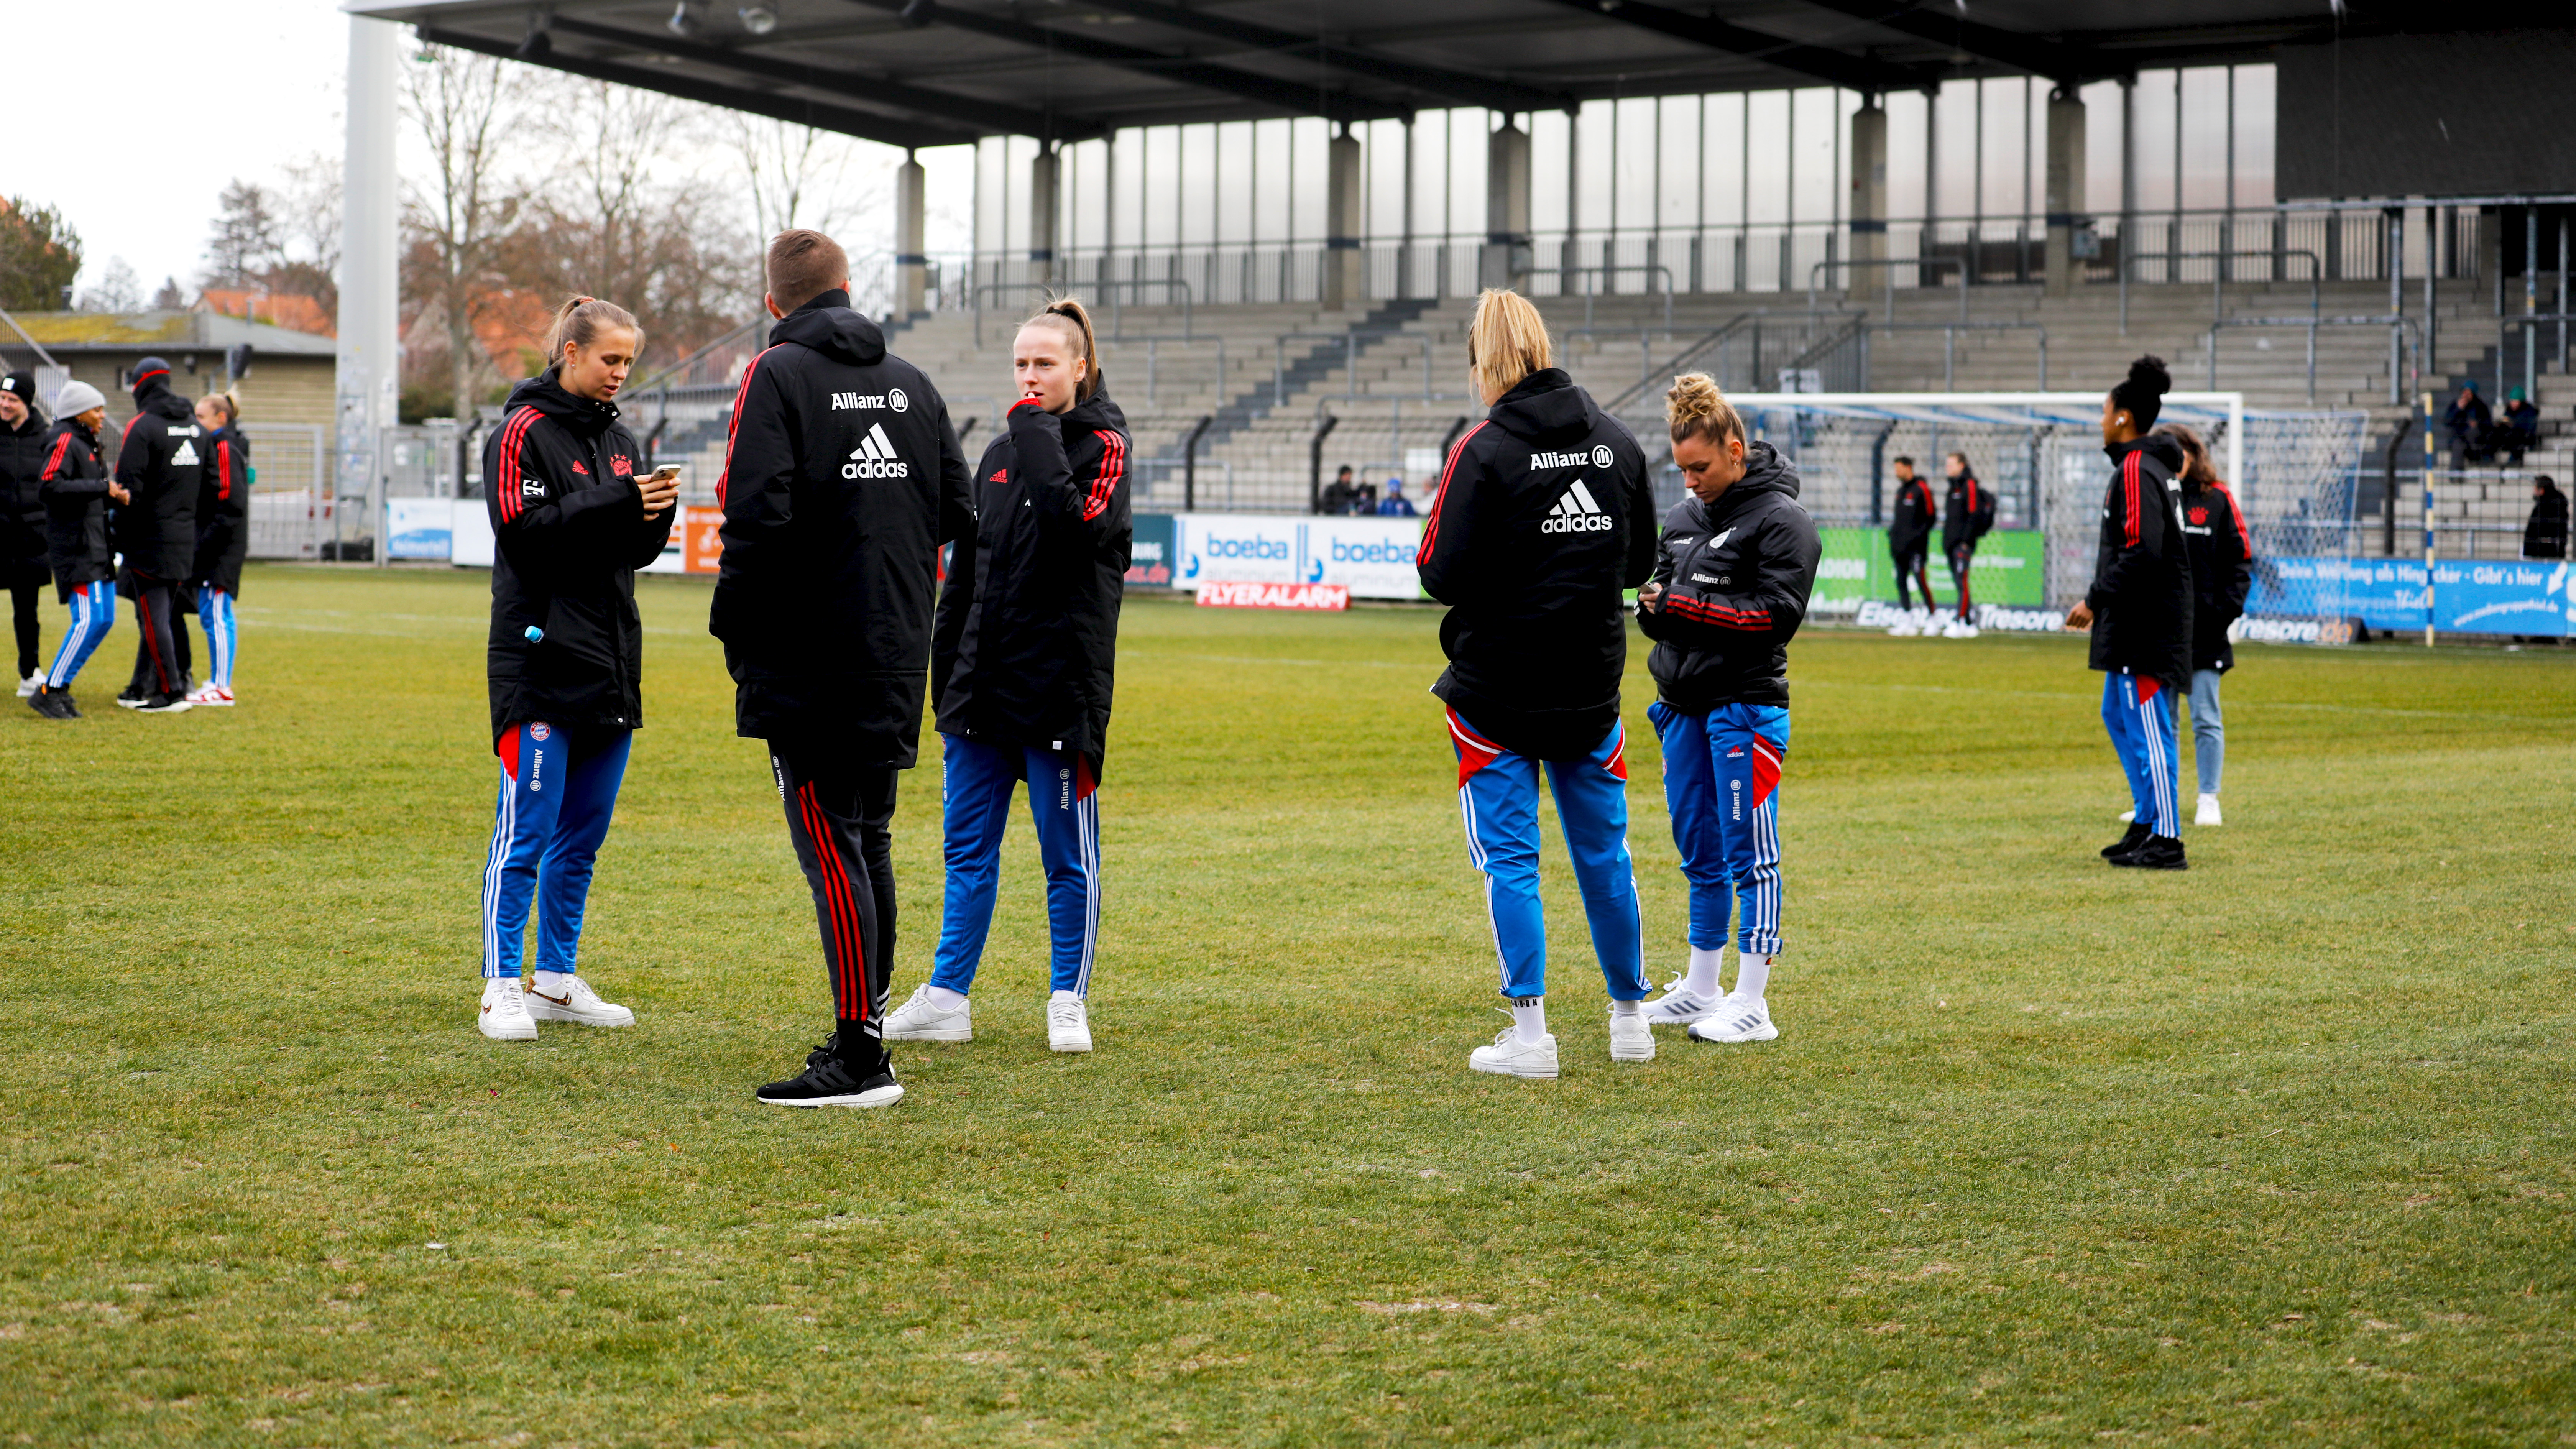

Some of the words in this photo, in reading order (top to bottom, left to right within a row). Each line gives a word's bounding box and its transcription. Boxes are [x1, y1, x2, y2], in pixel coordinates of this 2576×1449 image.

[831, 392, 886, 410] Allianz
[842, 458, 908, 479] adidas
[1530, 452, 1589, 470] Allianz
[1541, 512, 1612, 534] adidas
[1208, 532, 1288, 560] boeba
[1332, 536, 1417, 564] boeba
[1691, 573, 1719, 584] Allianz
[2376, 563, 2395, 582] als
[2517, 567, 2543, 585] hier
[1196, 583, 1348, 610] FLYERALARM
[533, 749, 543, 779] Allianz
[1061, 781, 1069, 810] Allianz
[1733, 792, 1741, 821] Allianz
